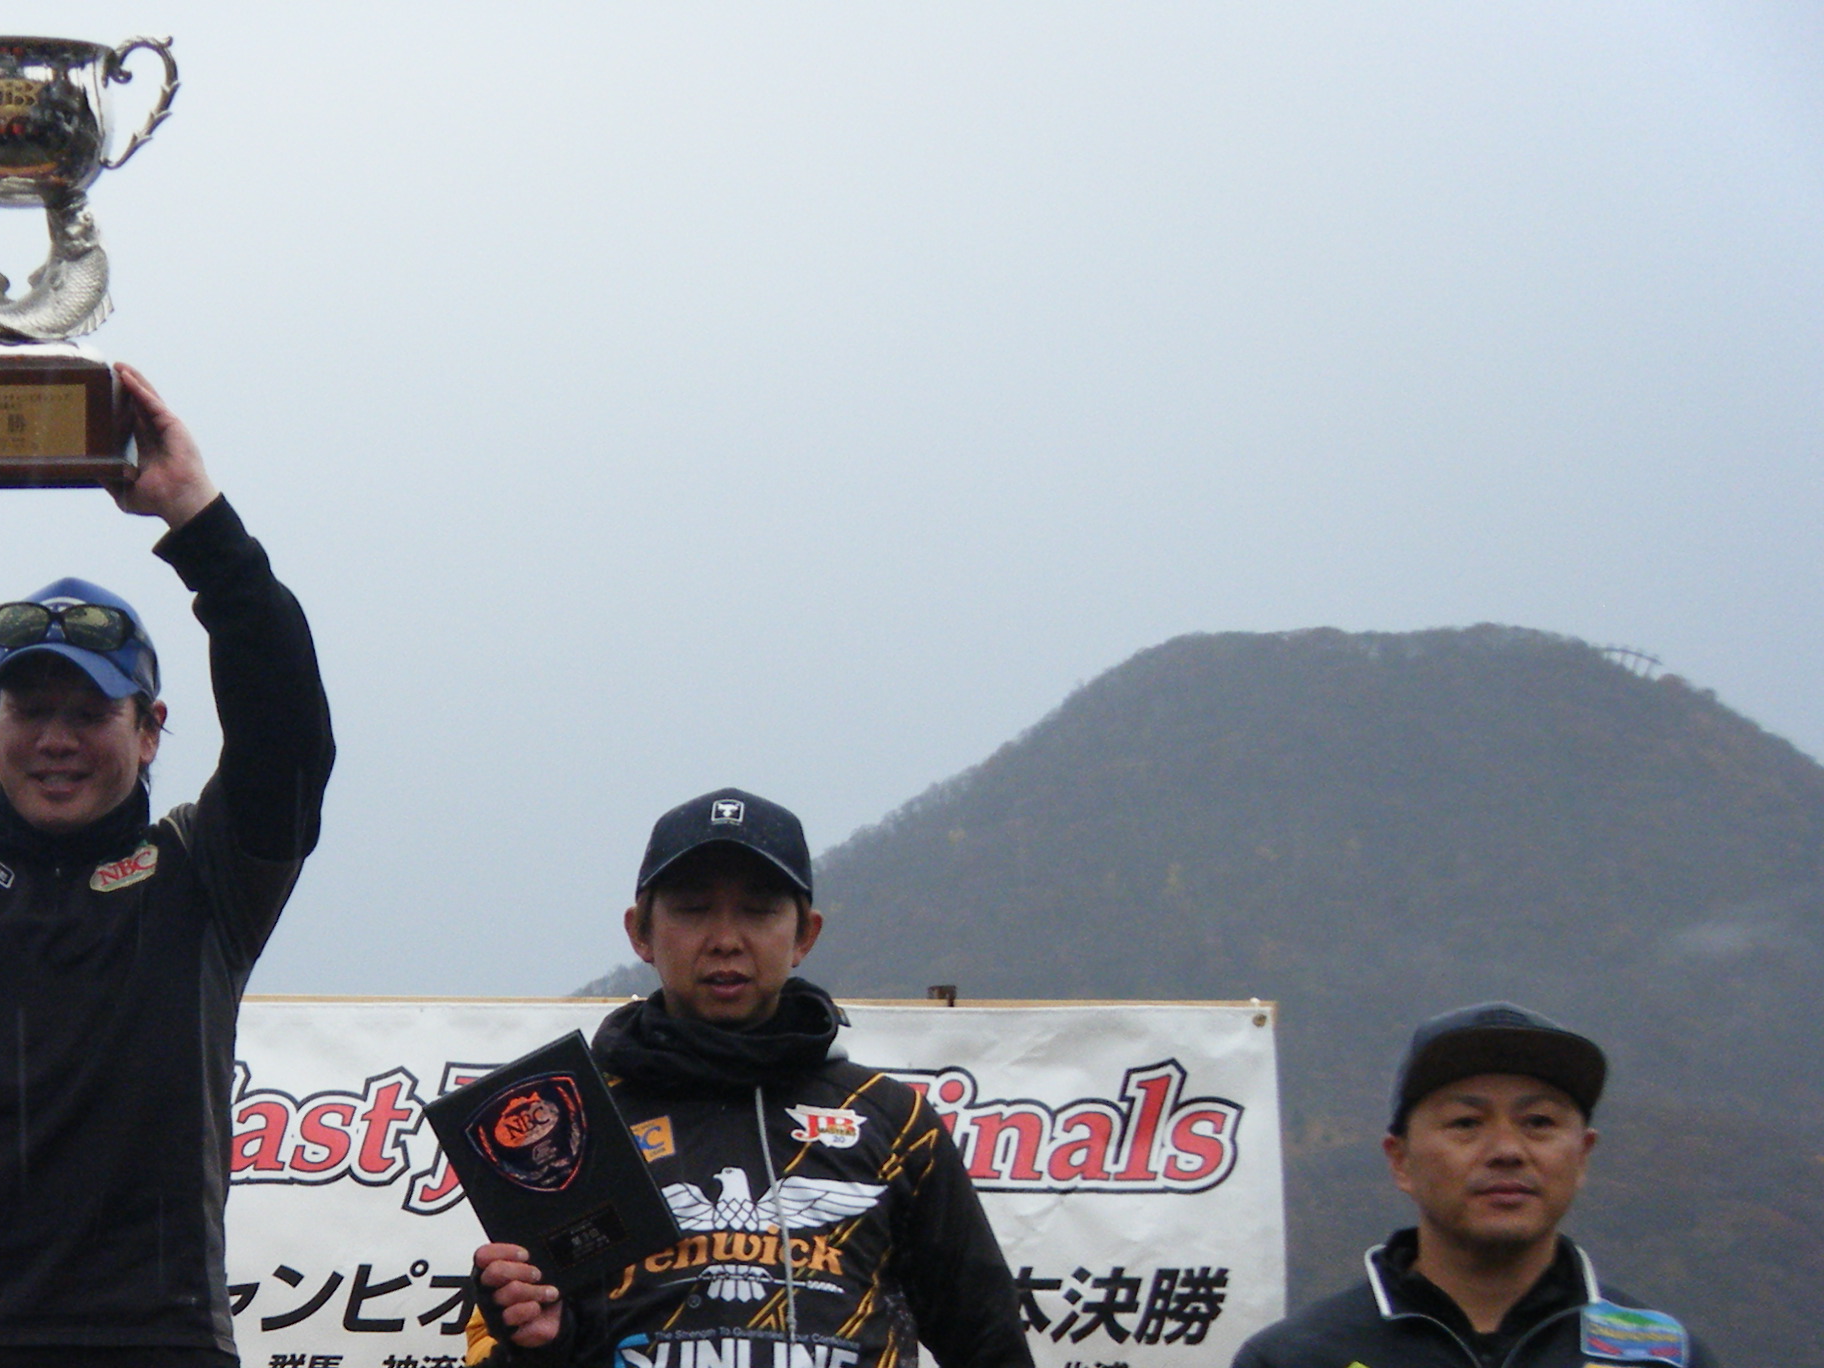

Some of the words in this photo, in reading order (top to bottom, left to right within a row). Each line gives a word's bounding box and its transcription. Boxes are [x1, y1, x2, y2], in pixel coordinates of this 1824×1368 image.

[98, 851, 156, 886] NBC
[232, 1075, 416, 1180] ast
[912, 1064, 1238, 1186] inals
[505, 1106, 551, 1141] NBC
[791, 1114, 856, 1141] JB
